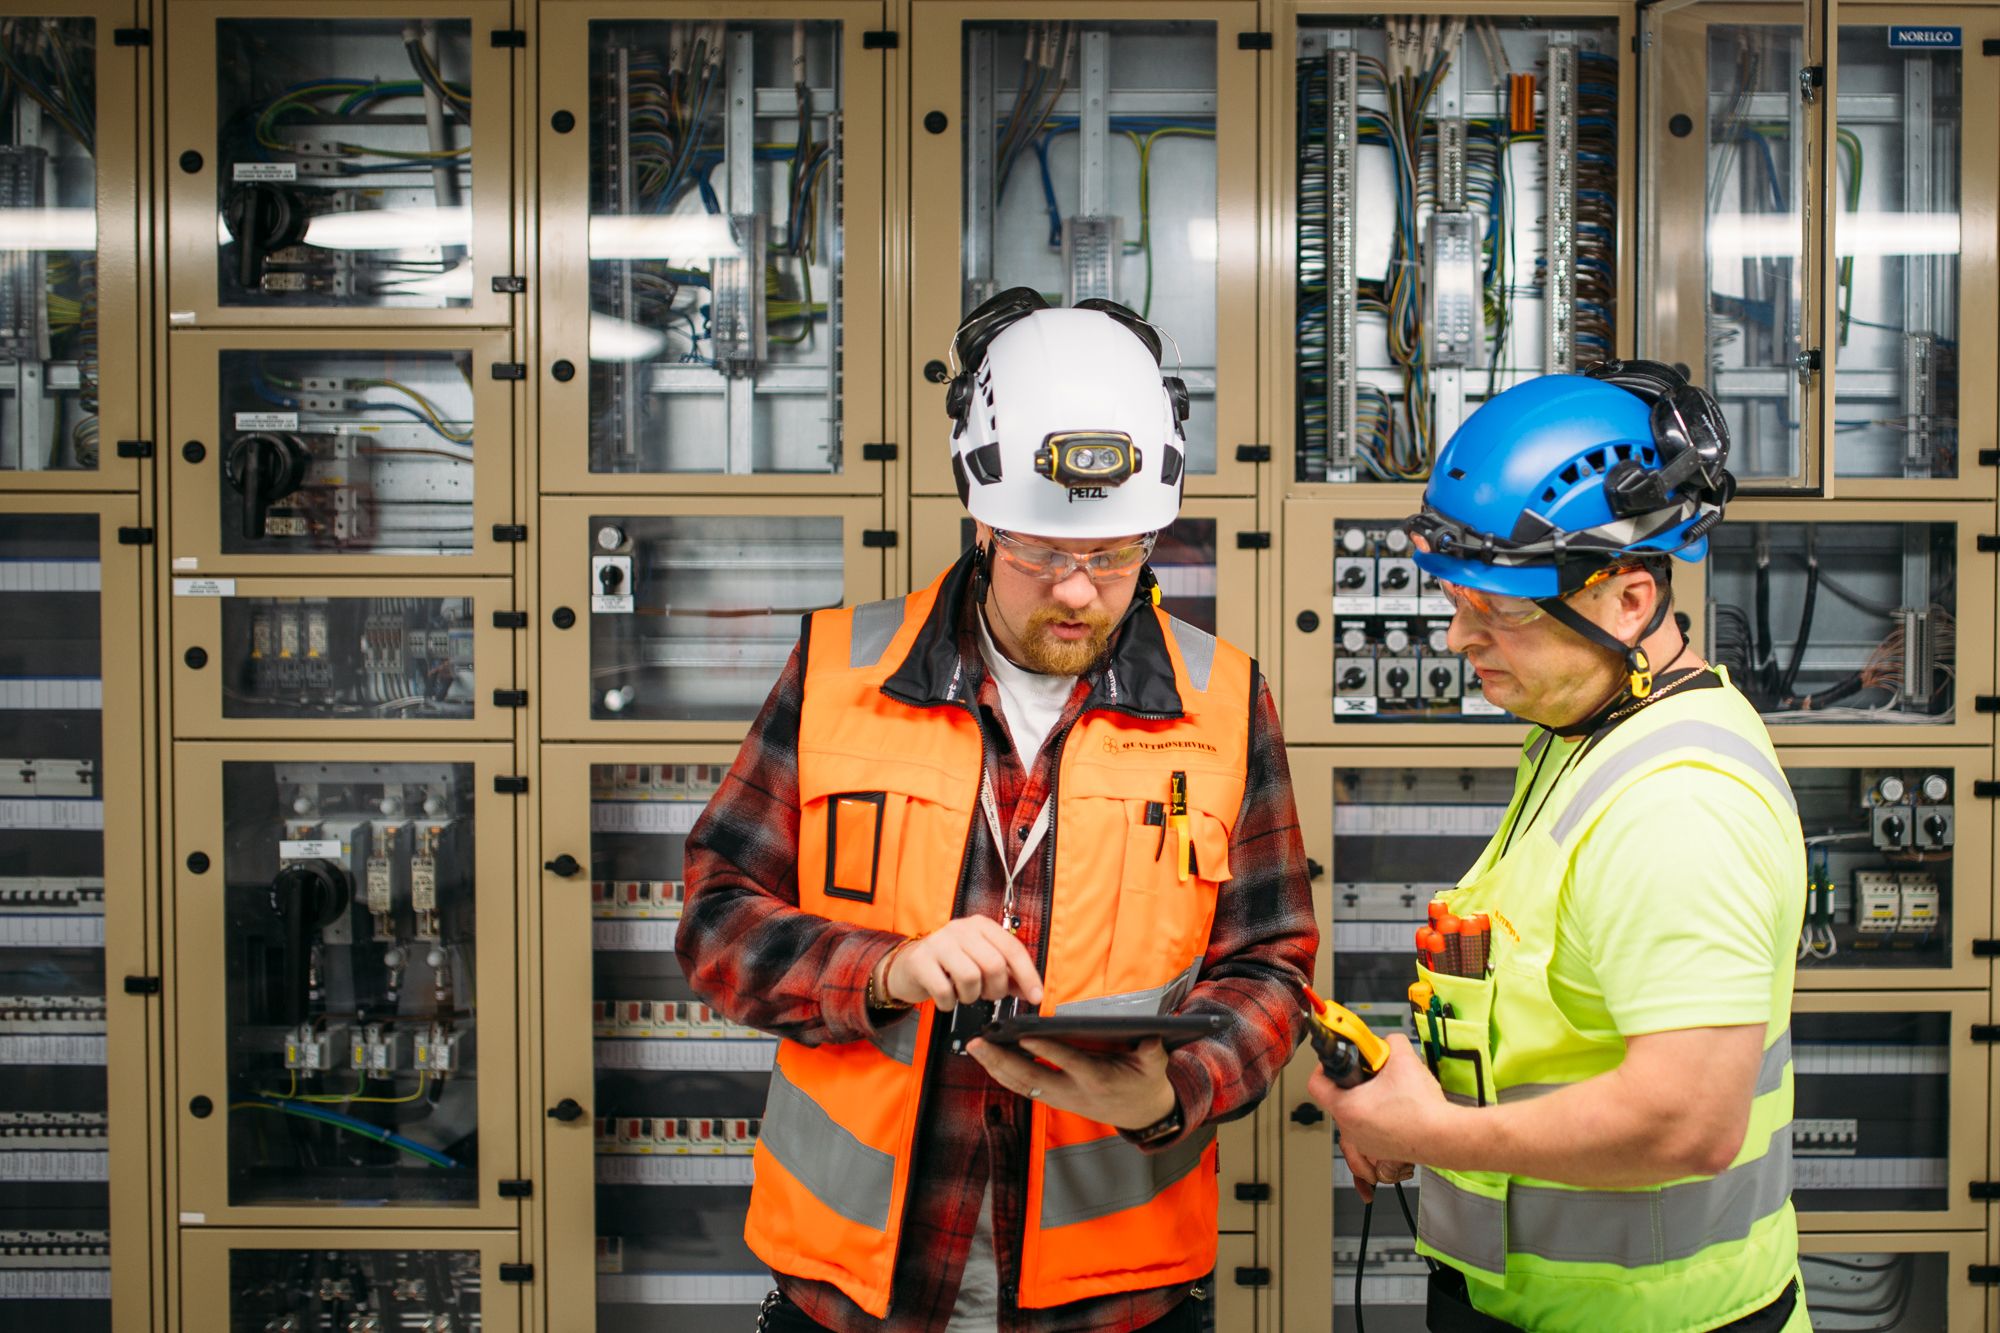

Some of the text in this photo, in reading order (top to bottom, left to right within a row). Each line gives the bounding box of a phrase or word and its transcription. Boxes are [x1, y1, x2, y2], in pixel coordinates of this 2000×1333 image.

[1899, 31, 1954, 43] NORELCO
[1069, 486, 1109, 504] PETZL
[1122, 741, 1217, 753] QUATTROSERVICES
